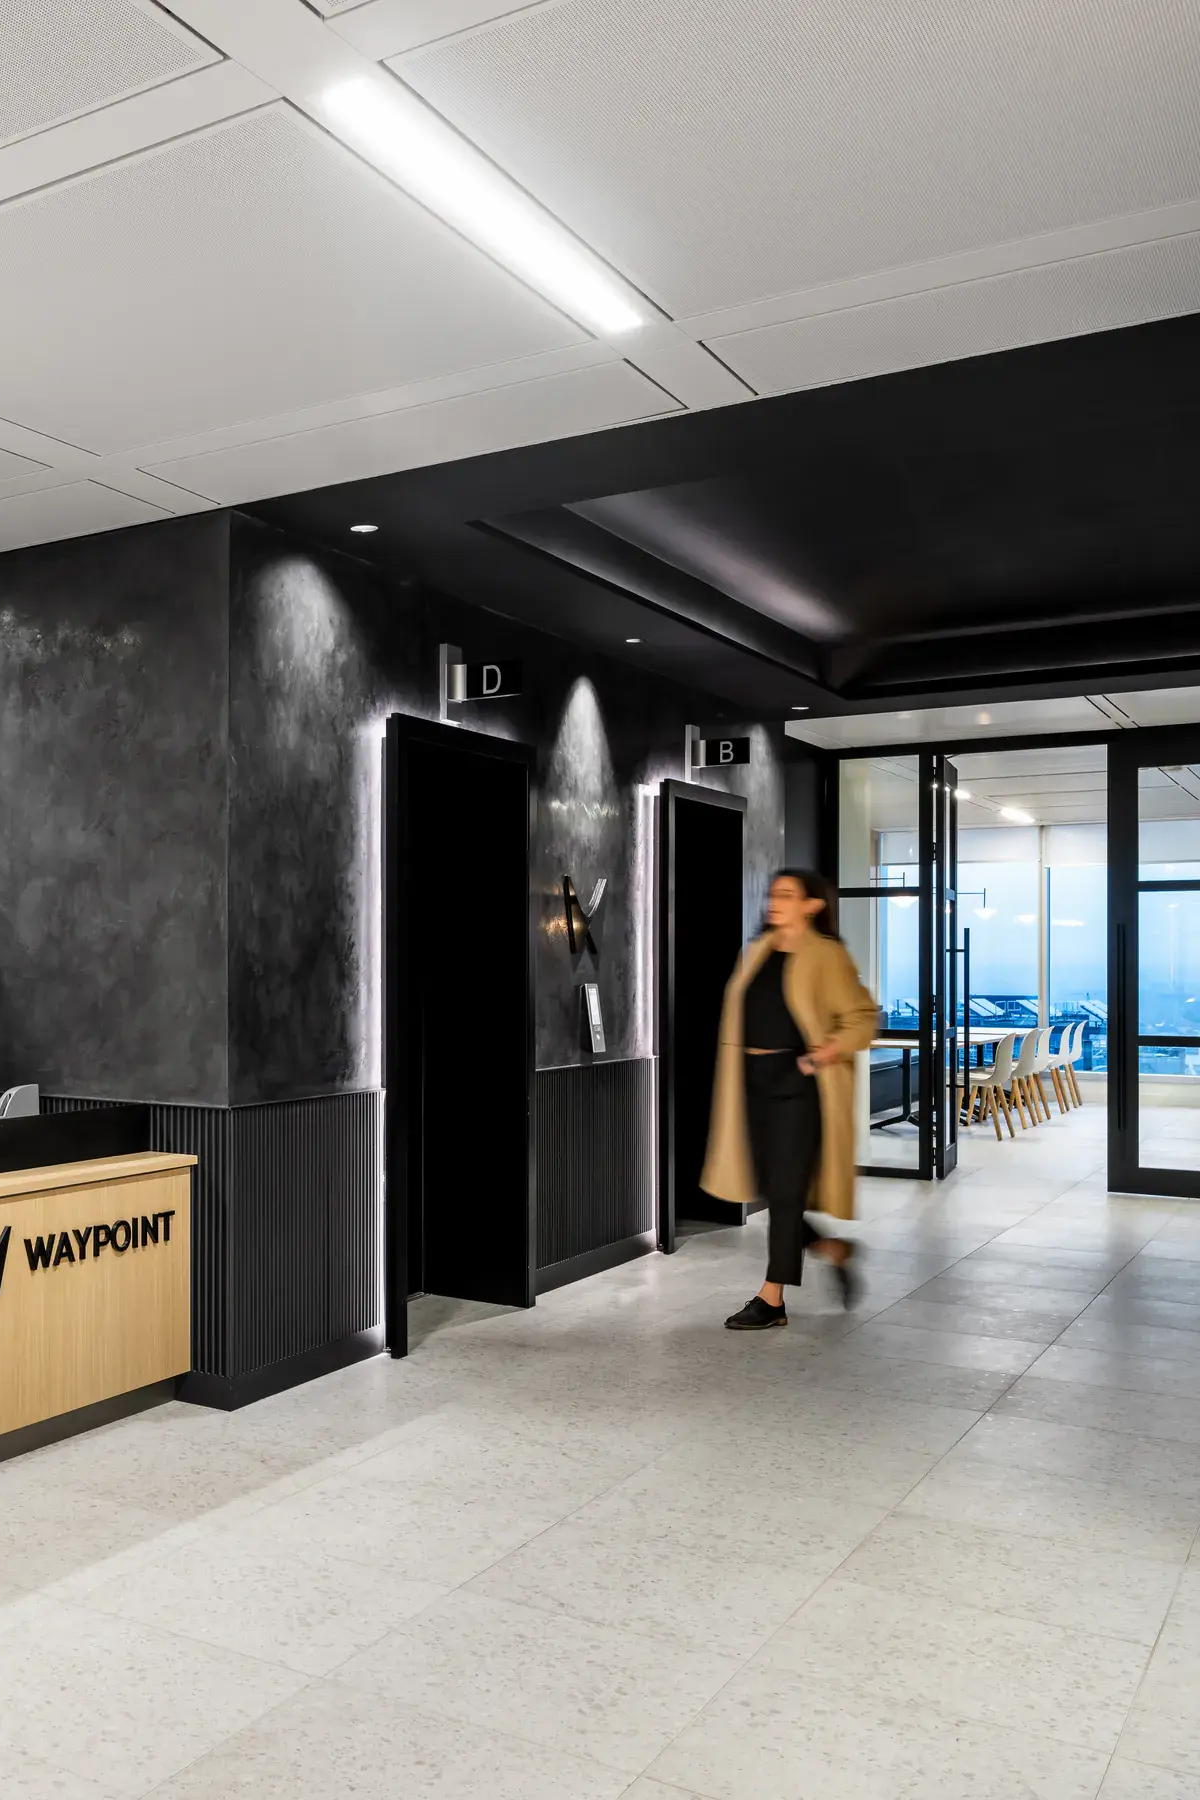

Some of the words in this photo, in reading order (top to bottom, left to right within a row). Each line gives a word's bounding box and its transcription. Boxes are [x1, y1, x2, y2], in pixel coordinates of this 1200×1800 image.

[483, 665, 501, 694] D
[720, 741, 734, 763] B
[23, 1210, 175, 1271] WAYPOINT
